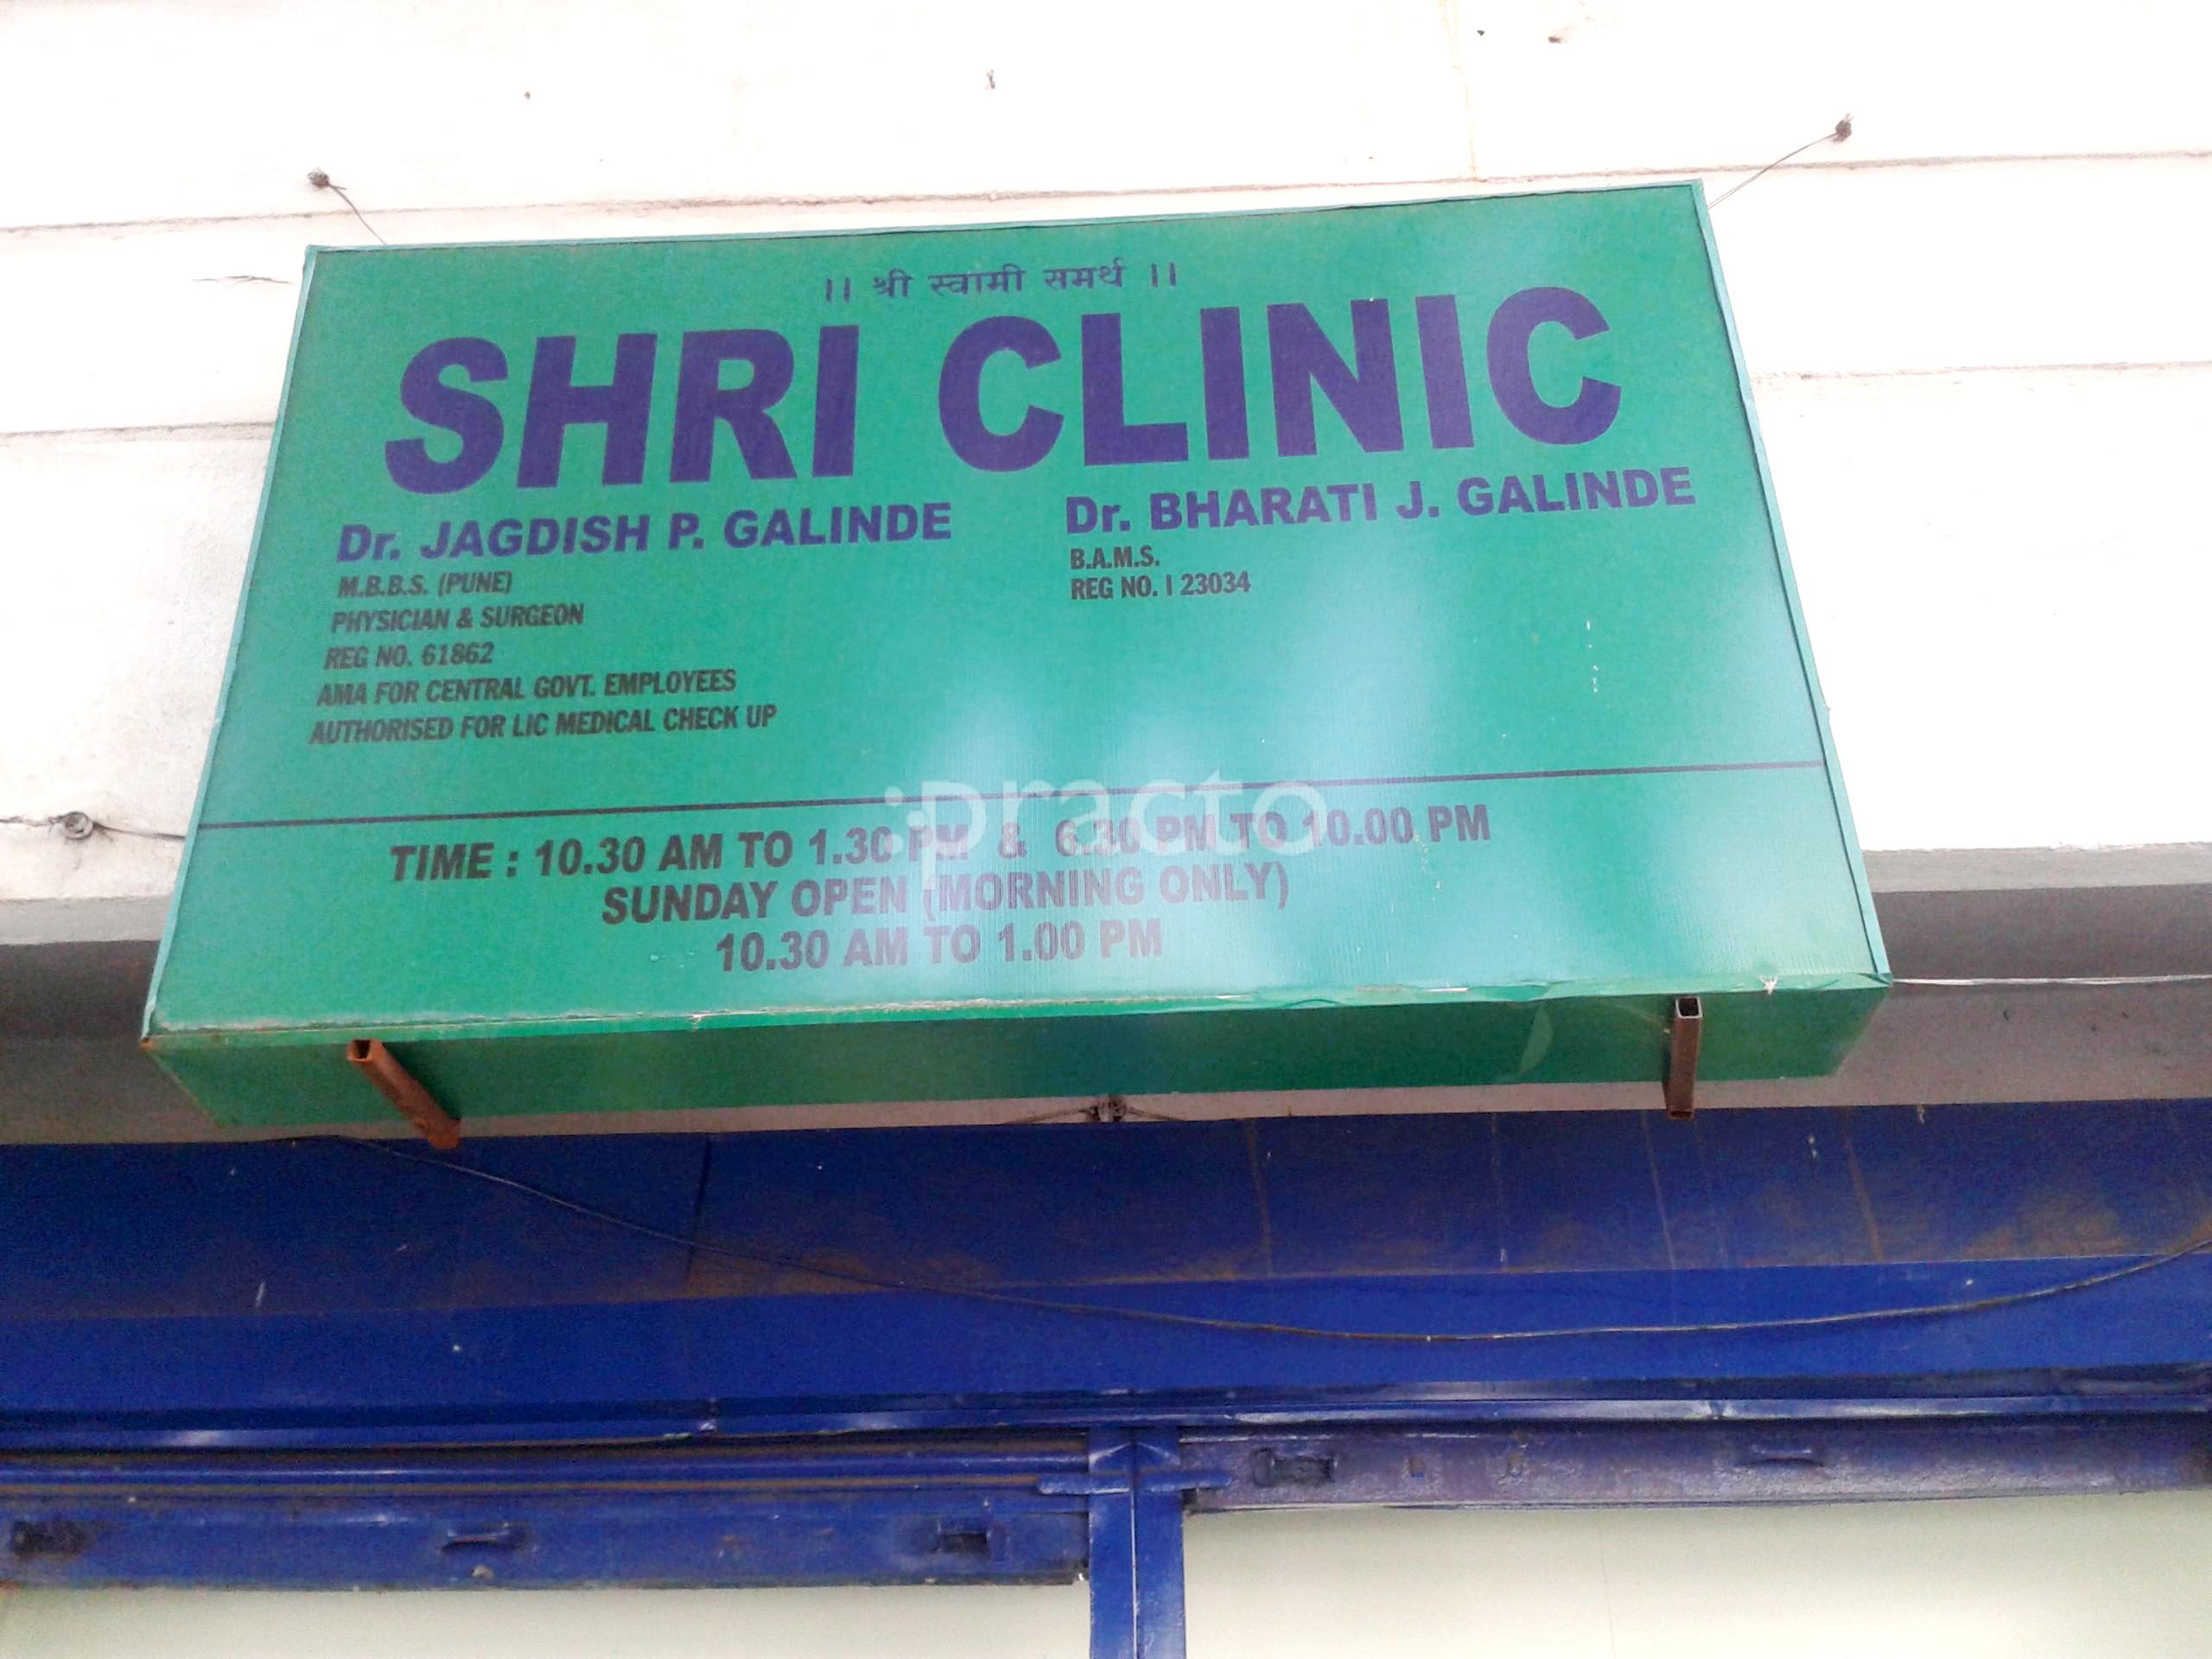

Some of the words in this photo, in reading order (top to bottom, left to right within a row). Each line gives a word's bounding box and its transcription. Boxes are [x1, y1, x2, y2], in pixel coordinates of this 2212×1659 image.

[872, 268, 914, 298] श्री
[927, 263, 1027, 296] स्वामी
[1043, 257, 1125, 290] समर्थ
[385, 324, 859, 494] SHRI
[938, 286, 1622, 473] CLINIC
[1066, 496, 1131, 534] Dr.
[1150, 483, 1378, 531] BHARATI
[1396, 480, 1440, 519] J.
[1458, 466, 1695, 516] GALINDE
[336, 523, 400, 562] Dr.
[419, 514, 651, 561] JAGDISH
[668, 512, 705, 551] P.
[723, 502, 951, 548] GALINDE
[1071, 545, 1160, 569] B.A.M.S.
[338, 574, 429, 598] M.B.B.S.
[437, 570, 512, 597] (PUNE)
[1071, 577, 1113, 600] REG
[1121, 575, 1158, 598] NO.
[1180, 571, 1251, 596] 23034
[331, 607, 449, 633] PHYSICIAN
[455, 607, 474, 629] &
[480, 603, 584, 628] SURGEON
[324, 647, 368, 670] REG
[376, 645, 413, 668] NO.
[422, 642, 495, 666] 61862
[316, 683, 367, 707] AMA
[373, 682, 418, 705] FOR
[425, 677, 524, 702] CENTRAL
[533, 675, 596, 699] GOVT.
[605, 669, 736, 696] EMPLOYEES
[308, 715, 454, 745] AUTHORISED
[461, 715, 507, 739] FOR
[512, 713, 549, 737] LIC
[556, 708, 655, 736] MEDICAL
[663, 706, 740, 732] CHECK
[747, 704, 778, 728] UP
[390, 842, 494, 881] TIME
[534, 836, 645, 876] 10.30
[658, 834, 723, 872] AM
[739, 830, 792, 868] TO
[810, 826, 892, 865] 1.30
[908, 823, 969, 862] PM
[998, 822, 1027, 859] &
[1055, 817, 1141, 858] 6.30
[1156, 814, 1213, 854] PM
[1230, 811, 1287, 852] TO
[1304, 807, 1414, 849] 10.00
[1427, 804, 1491, 843] PM
[602, 880, 778, 925] SUNDAY
[791, 876, 906, 918] OPEN
[922, 867, 1144, 922] (MORNING
[1159, 861, 1289, 910] ONLY)
[717, 931, 830, 971] 10.30
[844, 927, 908, 967] AM
[924, 925, 981, 964] TO
[998, 920, 1084, 962] 1.00
[1099, 918, 1163, 958] PM
